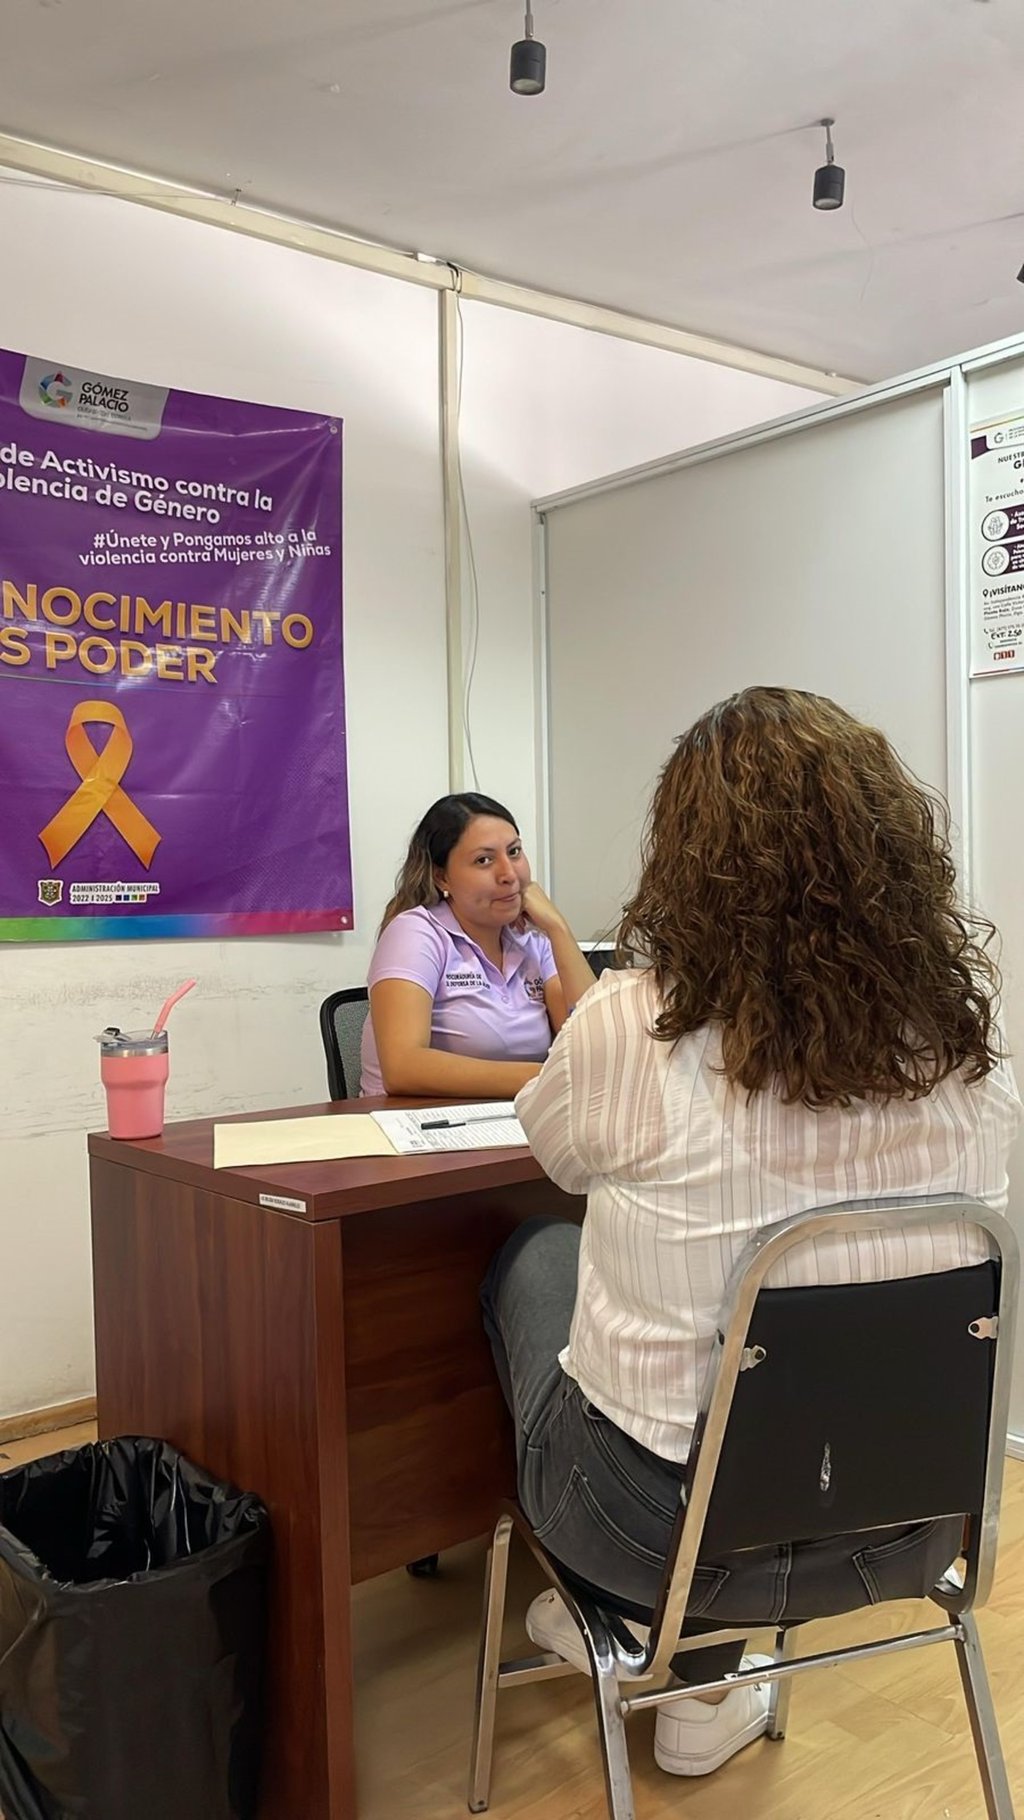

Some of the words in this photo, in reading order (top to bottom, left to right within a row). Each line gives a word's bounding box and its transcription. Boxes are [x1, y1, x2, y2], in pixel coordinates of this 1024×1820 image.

[79, 393, 129, 412] PALACIO
[81, 382, 129, 401] GÓMEZ
[0, 443, 35, 467] de
[40, 450, 169, 491] Activismo
[175, 480, 249, 507] contra
[254, 489, 272, 512] la
[95, 484, 128, 509] de
[134, 490, 220, 524] Género
[93, 529, 157, 549] #Únete
[160, 536, 170, 551] y
[173, 532, 252, 551] Pongamos
[255, 530, 284, 545] alto
[287, 533, 298, 543] a
[301, 528, 316, 541] la
[79, 549, 156, 566] violencia
[160, 550, 211, 563] contra
[214, 547, 274, 566] Mujeres
[276, 549, 285, 563] y
[288, 543, 331, 558] Niñas
[990, 584, 1024, 598] ¡VISÍTAN
[1, 580, 314, 650] NOCIMIENTO
[0, 626, 31, 666] S
[46, 631, 218, 685] PODER
[72, 883, 125, 892] ADMINISTRACIÓN
[72, 894, 89, 902] 2022
[96, 894, 113, 902] 2025
